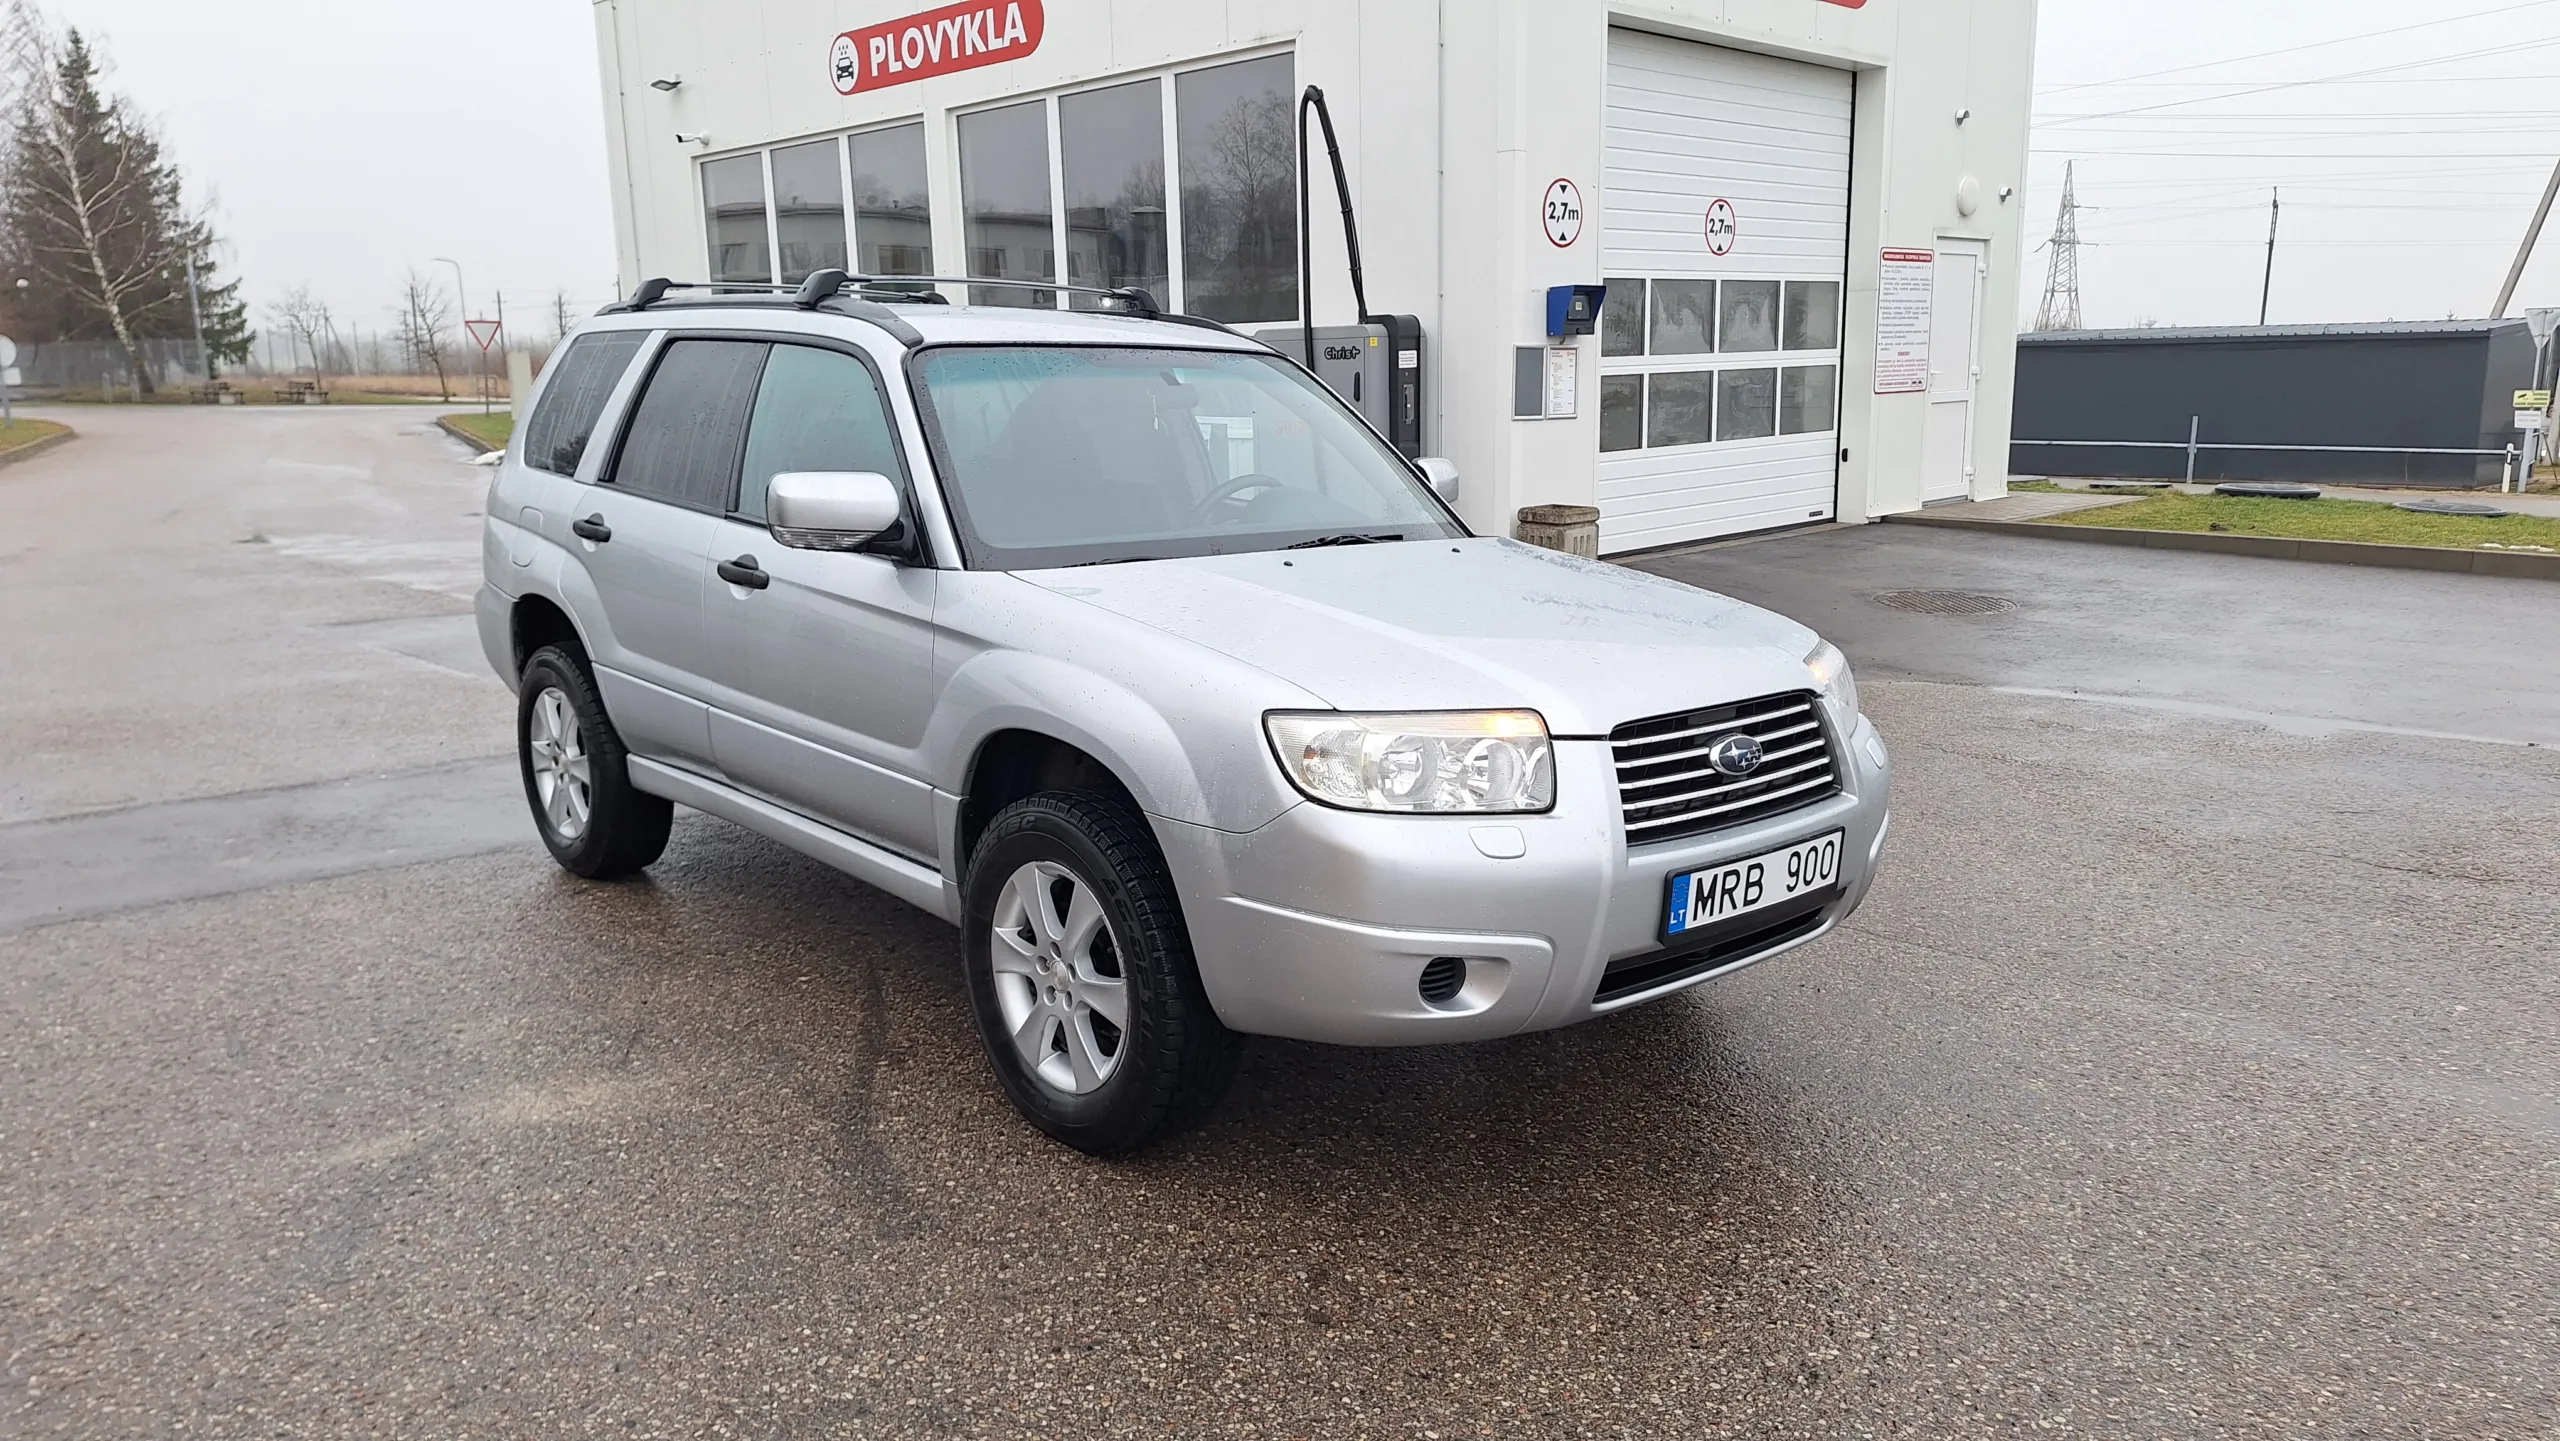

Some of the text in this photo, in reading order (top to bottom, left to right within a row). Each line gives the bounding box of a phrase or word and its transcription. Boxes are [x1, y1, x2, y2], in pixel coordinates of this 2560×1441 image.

[869, 2, 1027, 77] PLOVYKLA
[1548, 202, 1579, 223] 2,7m
[1709, 218, 1733, 236] 2,7m
[1324, 345, 1361, 360] Christ
[1693, 840, 1835, 921] MRB 900
[1670, 909, 1685, 925] LT
